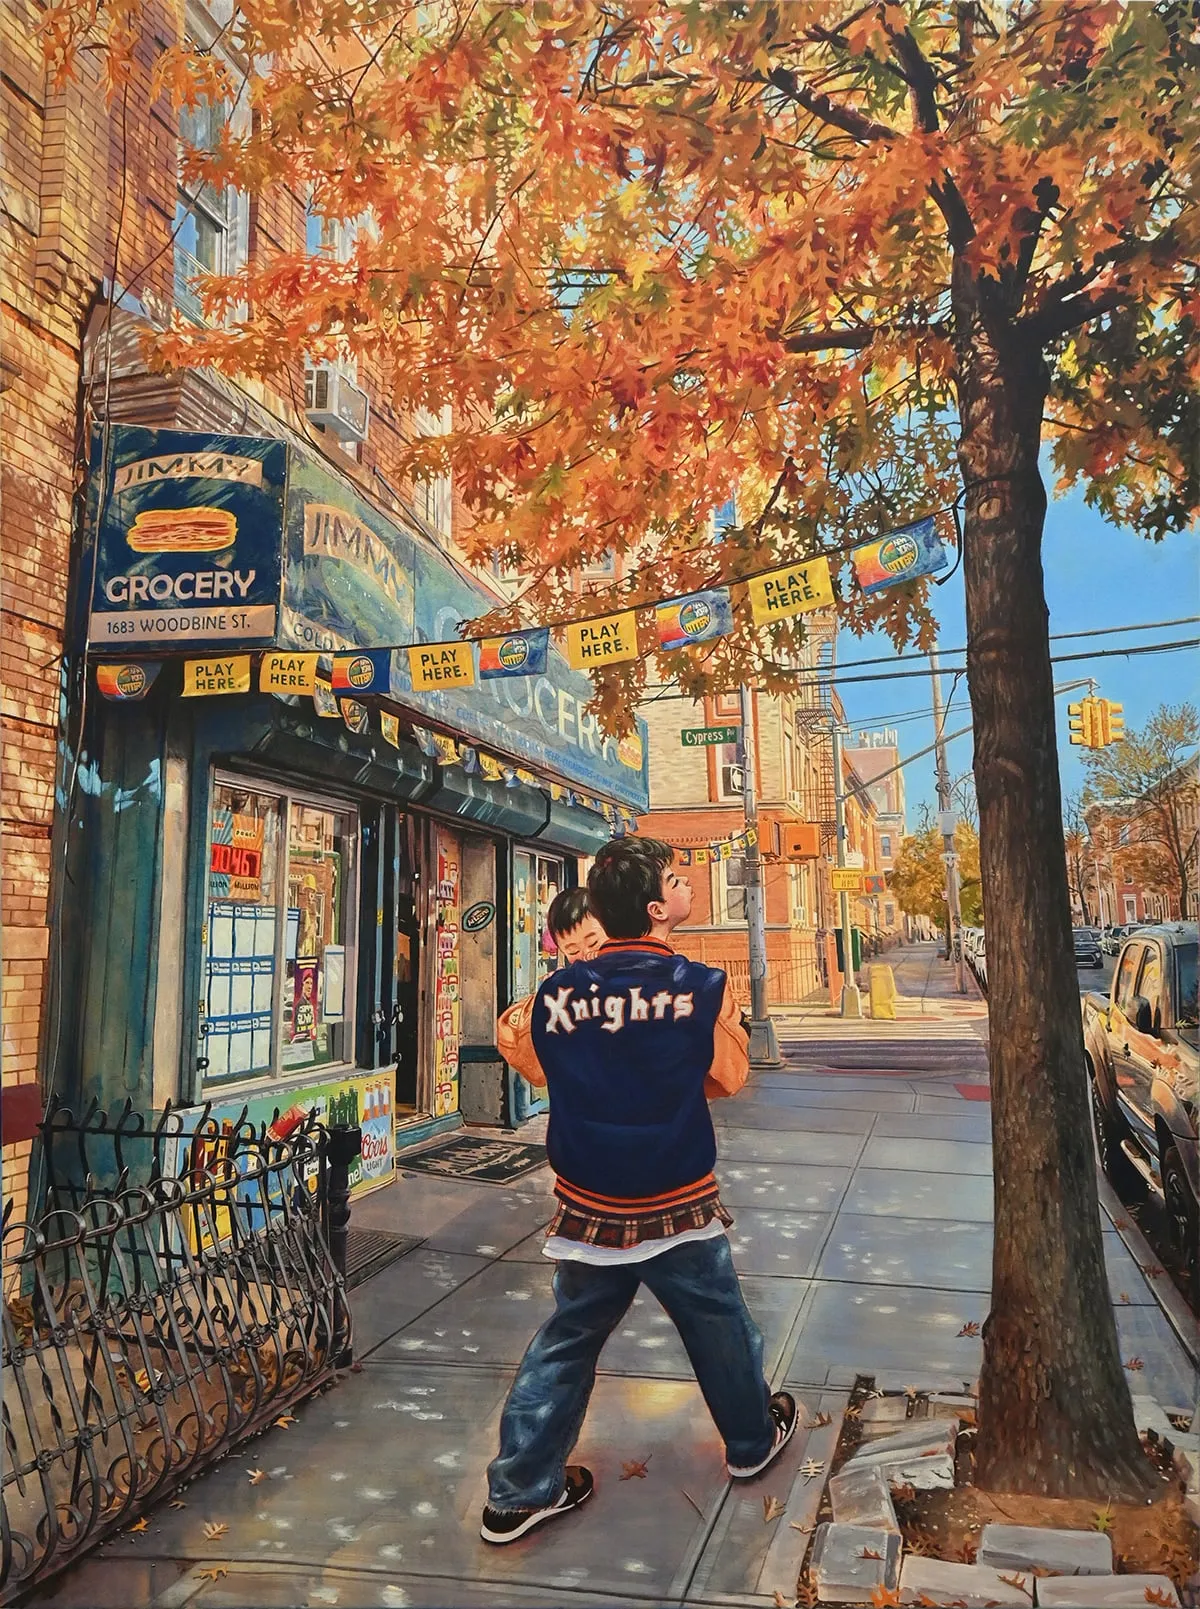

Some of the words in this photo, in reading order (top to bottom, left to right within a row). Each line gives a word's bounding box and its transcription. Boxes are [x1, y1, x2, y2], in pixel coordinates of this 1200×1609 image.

[124, 457, 249, 485] JIMMY
[105, 569, 256, 603] GROCERY
[763, 569, 808, 596] PLAY
[766, 585, 820, 611] HERE.
[107, 621, 135, 634] 1683
[140, 615, 227, 632] WOODBINE
[231, 614, 251, 629] ST.
[580, 622, 619, 641] PLAY
[293, 623, 333, 650] COLD
[420, 649, 457, 667] PLAY
[581, 639, 629, 658] HERE.
[195, 663, 234, 677] PLAY
[270, 658, 305, 672] PLAY
[422, 664, 467, 681] HERE.
[196, 677, 241, 690] HERE.
[270, 673, 310, 687] HERE.
[685, 731, 724, 745] Cypress
[543, 984, 694, 1034] Knights
[361, 1133, 388, 1161] Coors
